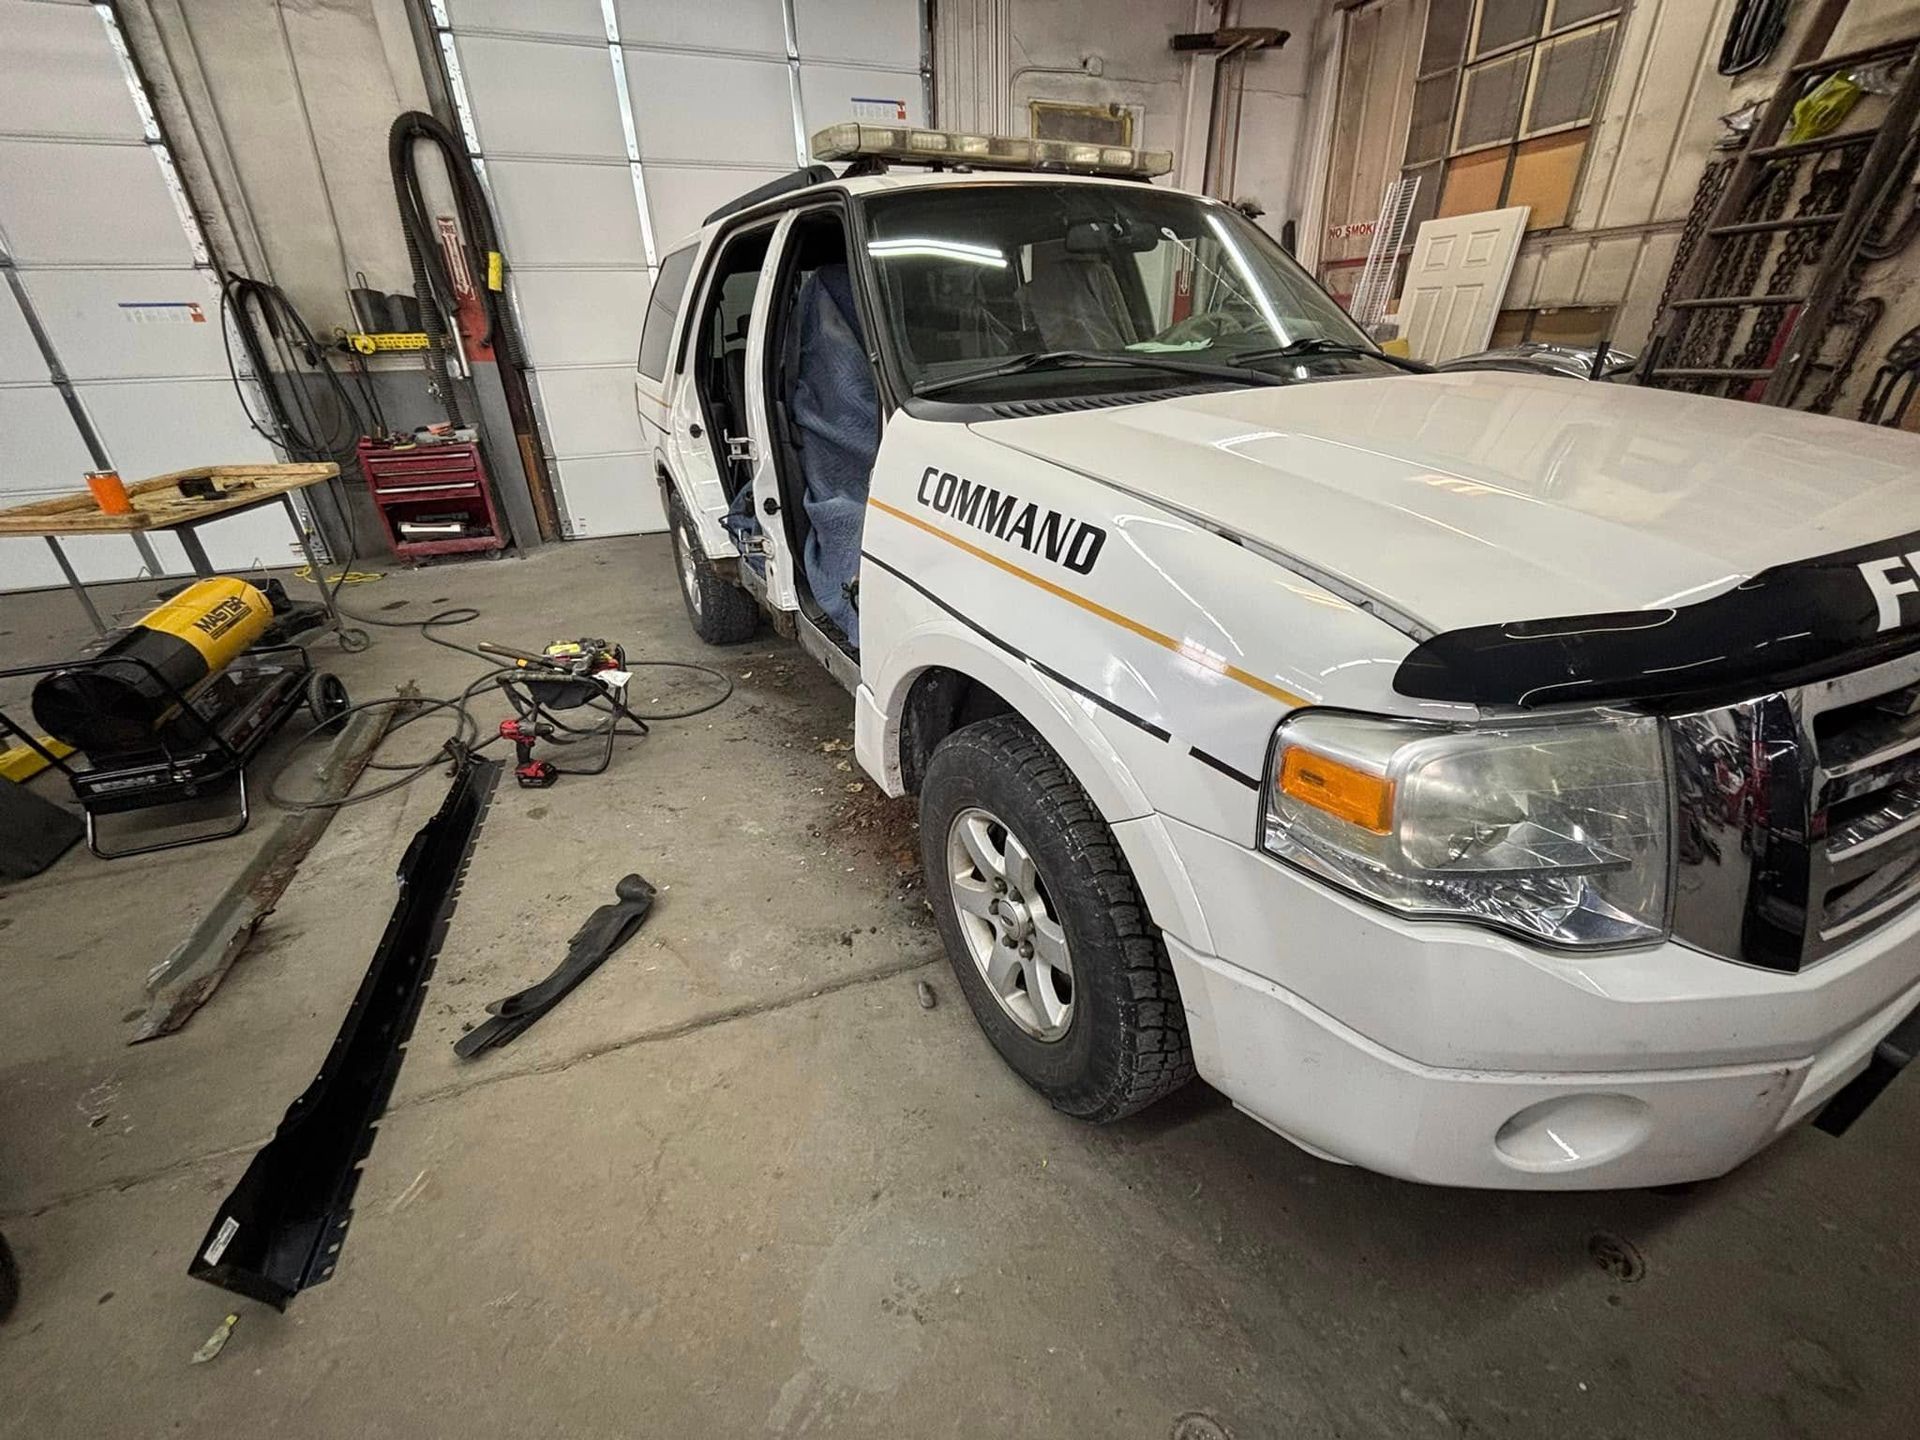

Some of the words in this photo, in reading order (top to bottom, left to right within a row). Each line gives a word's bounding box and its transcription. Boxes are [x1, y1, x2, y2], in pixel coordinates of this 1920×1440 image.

[1328, 227, 1342, 239] NO
[1345, 221, 1386, 239] SMOKI
[917, 466, 1107, 575] COMMAND
[192, 596, 247, 633] MASTER
